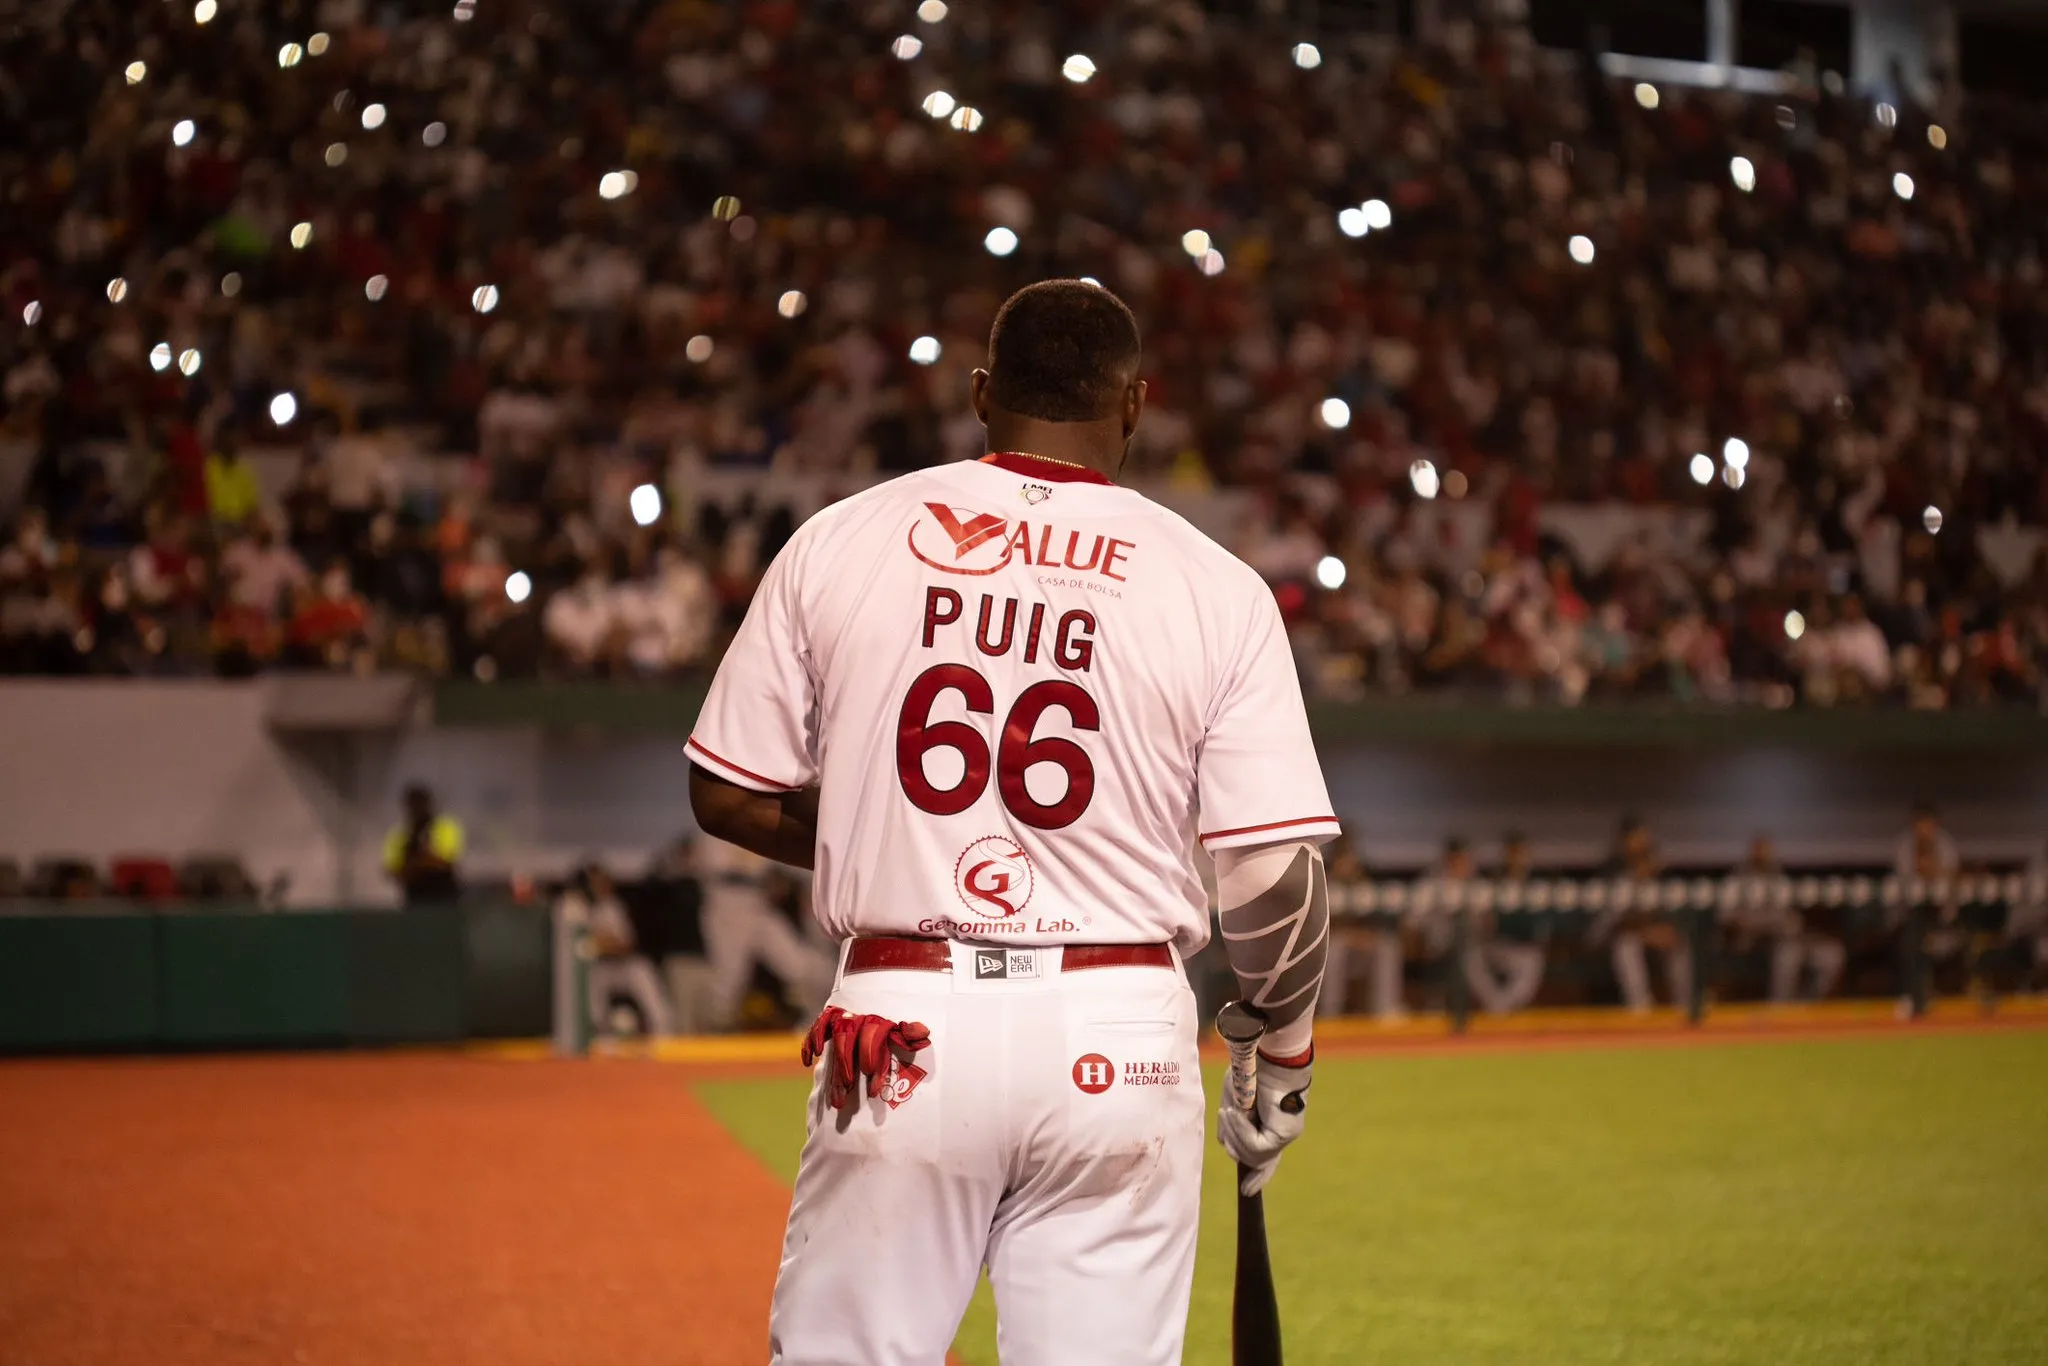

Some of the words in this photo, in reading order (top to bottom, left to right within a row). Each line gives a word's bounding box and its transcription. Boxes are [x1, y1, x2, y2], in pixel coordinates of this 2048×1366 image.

[1037, 576, 1066, 587] CASA
[1069, 579, 1083, 589] DE
[1087, 582, 1122, 599] BOLSA
[921, 585, 1096, 673] PUIG
[896, 662, 1101, 830] 66
[1010, 955, 1032, 964] NEW
[1010, 964, 1032, 972] ERA
[1080, 1062, 1108, 1085] H
[1125, 1062, 1180, 1074] HERALDO
[1124, 1076, 1159, 1085] MEDIA
